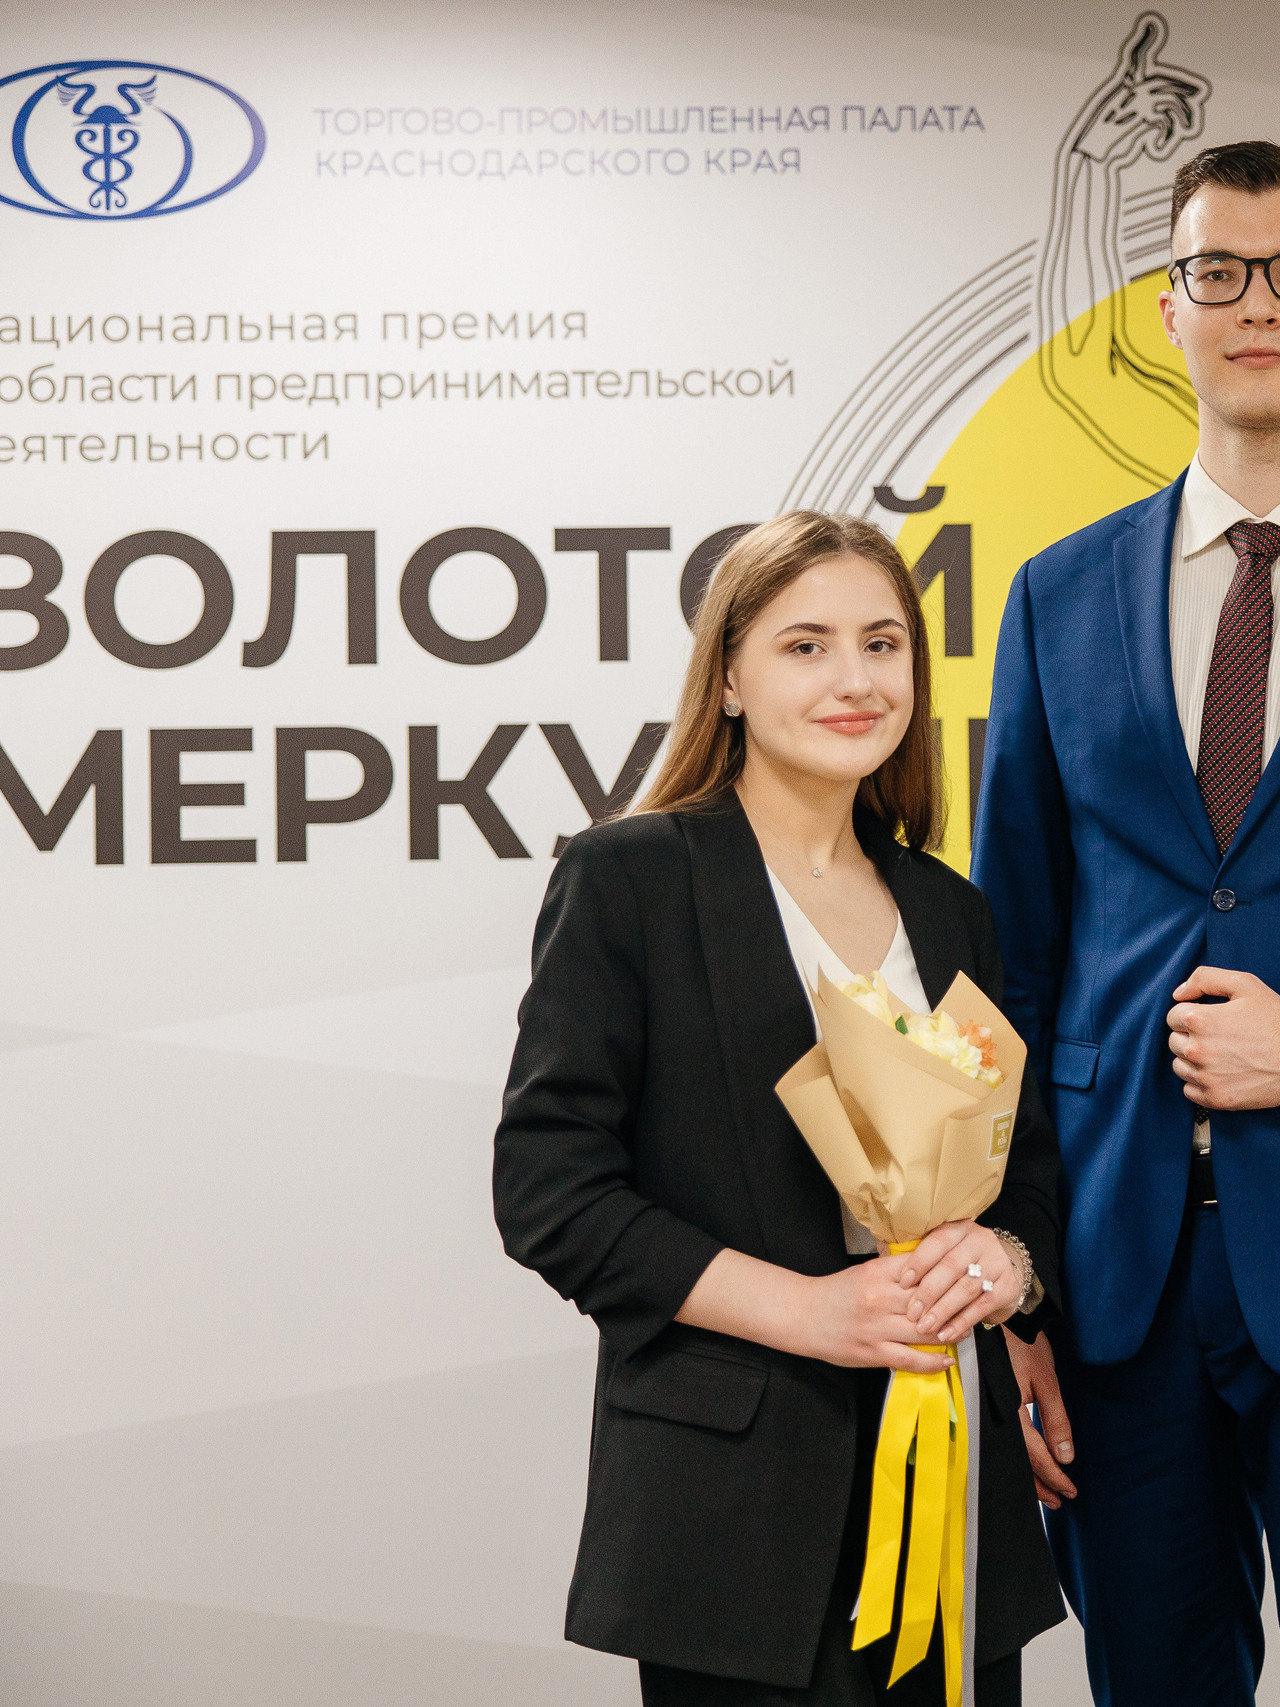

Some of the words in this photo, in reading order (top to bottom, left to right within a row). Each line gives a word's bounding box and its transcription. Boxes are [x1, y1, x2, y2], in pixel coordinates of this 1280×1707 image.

[313, 104, 832, 139] ТОРГОВО-ПРОМЫШЛЕННАЯ
[841, 104, 986, 133] ПАЛАТА
[314, 147, 692, 178] КРАСНОДАРСКОГО
[704, 146, 802, 175] КРАЯ
[381, 308, 588, 350] премия
[0, 361, 198, 404] области
[213, 357, 797, 411] предпринимательской
[0, 486, 974, 672] ЗОЛОТЙ
